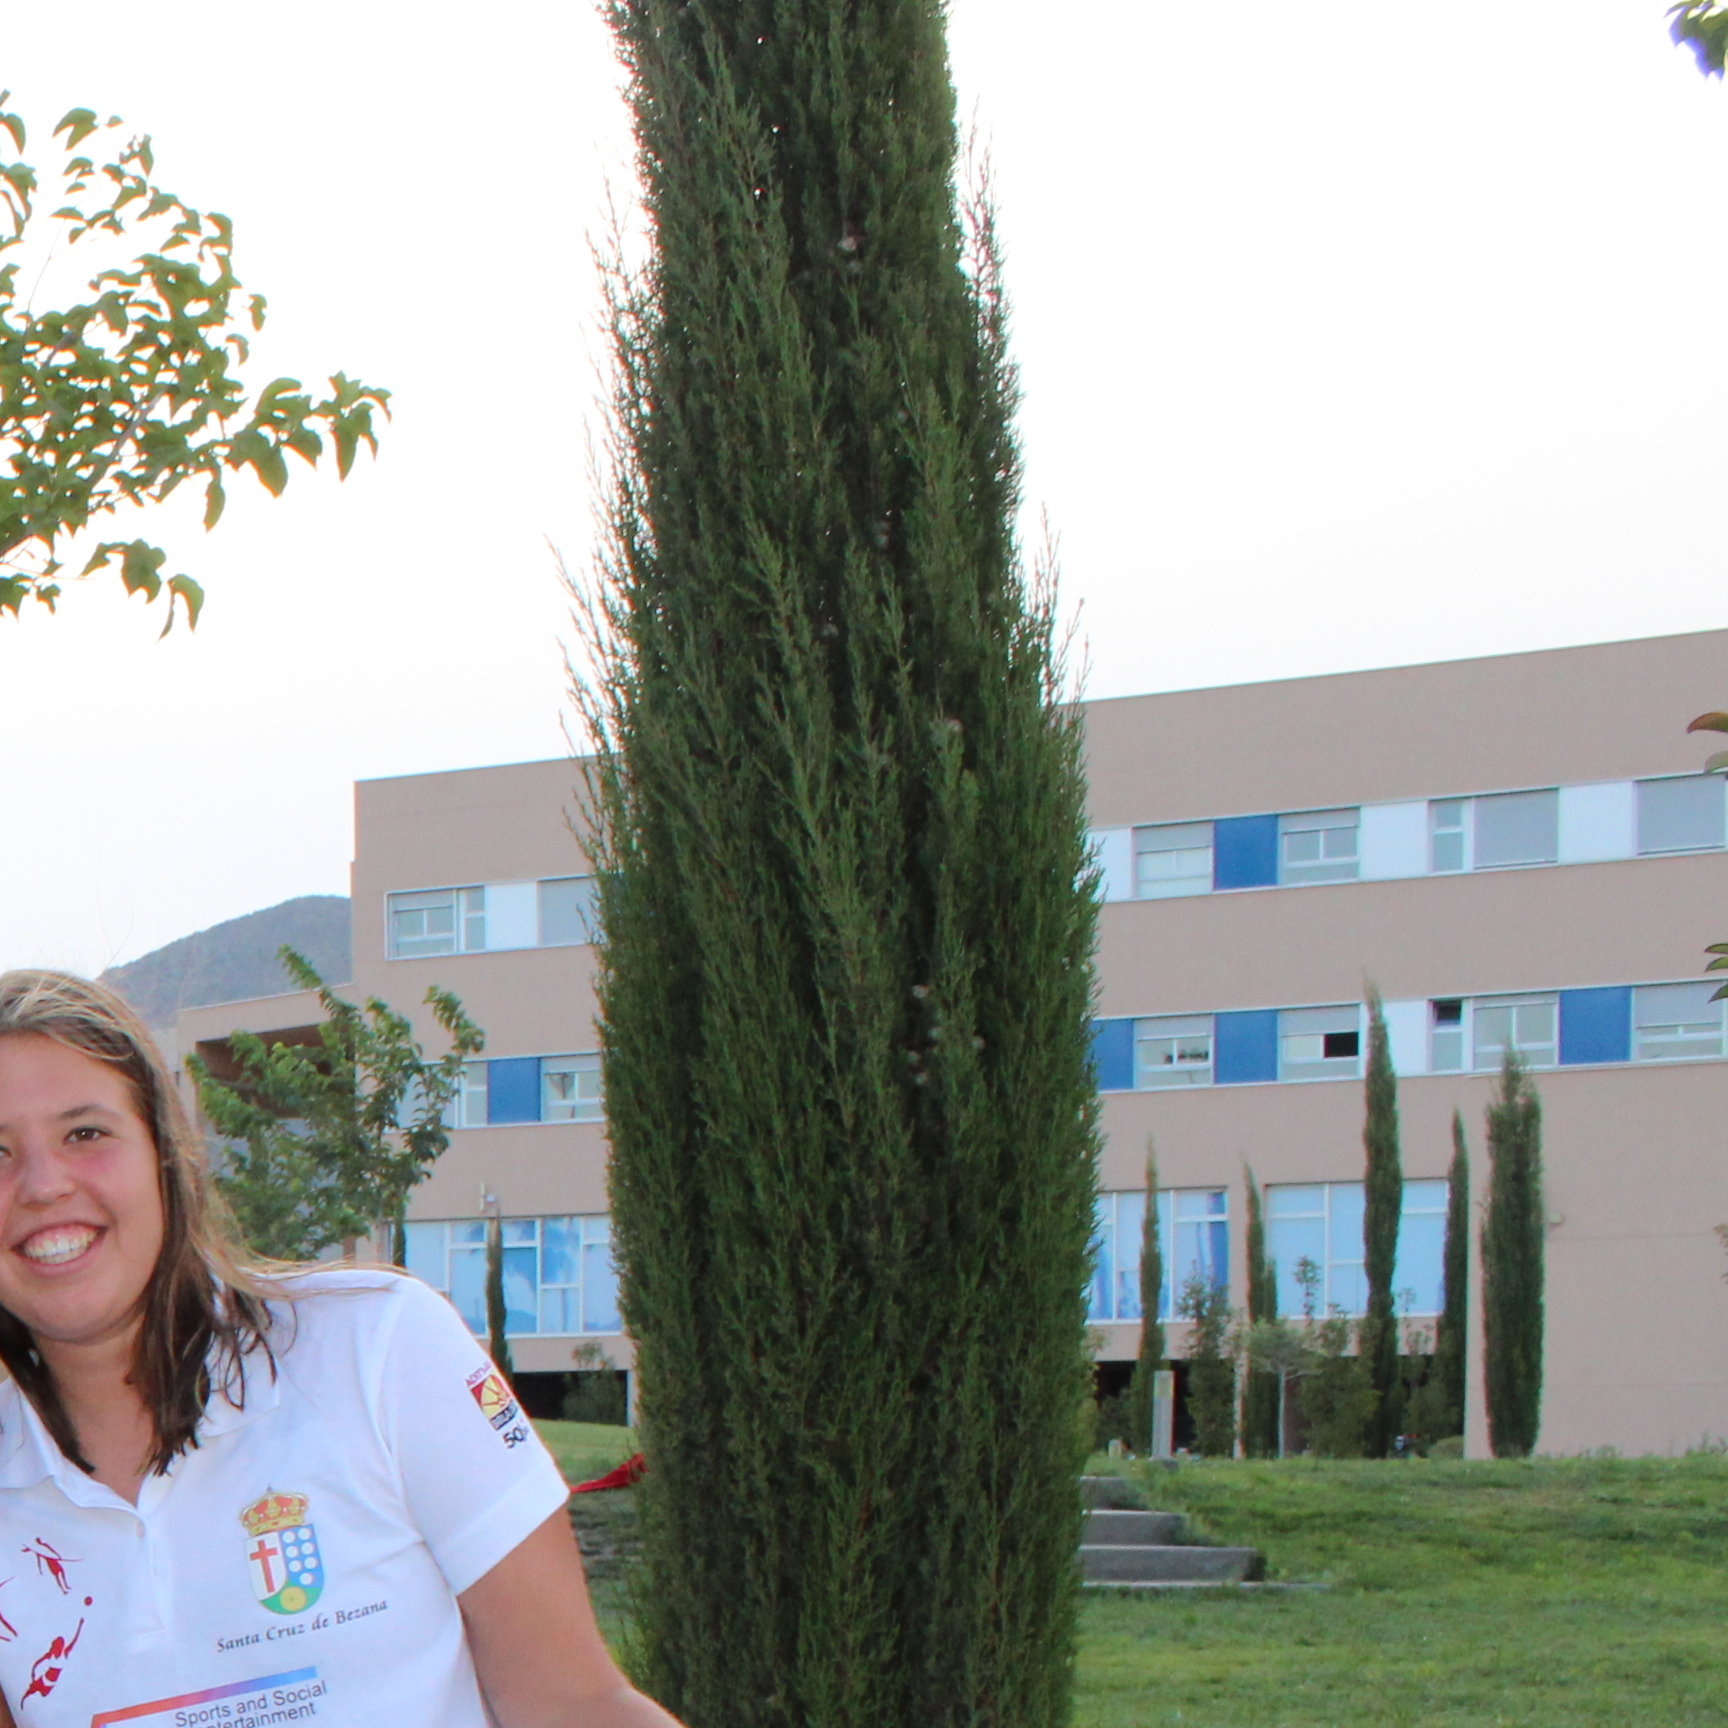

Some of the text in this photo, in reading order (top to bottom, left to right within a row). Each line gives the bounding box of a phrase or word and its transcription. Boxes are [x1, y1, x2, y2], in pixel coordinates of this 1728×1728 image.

[217, 1600, 388, 1653] Santa Cruz de Bezana
[236, 1694, 268, 1715] and
[272, 1680, 328, 1707] Social
